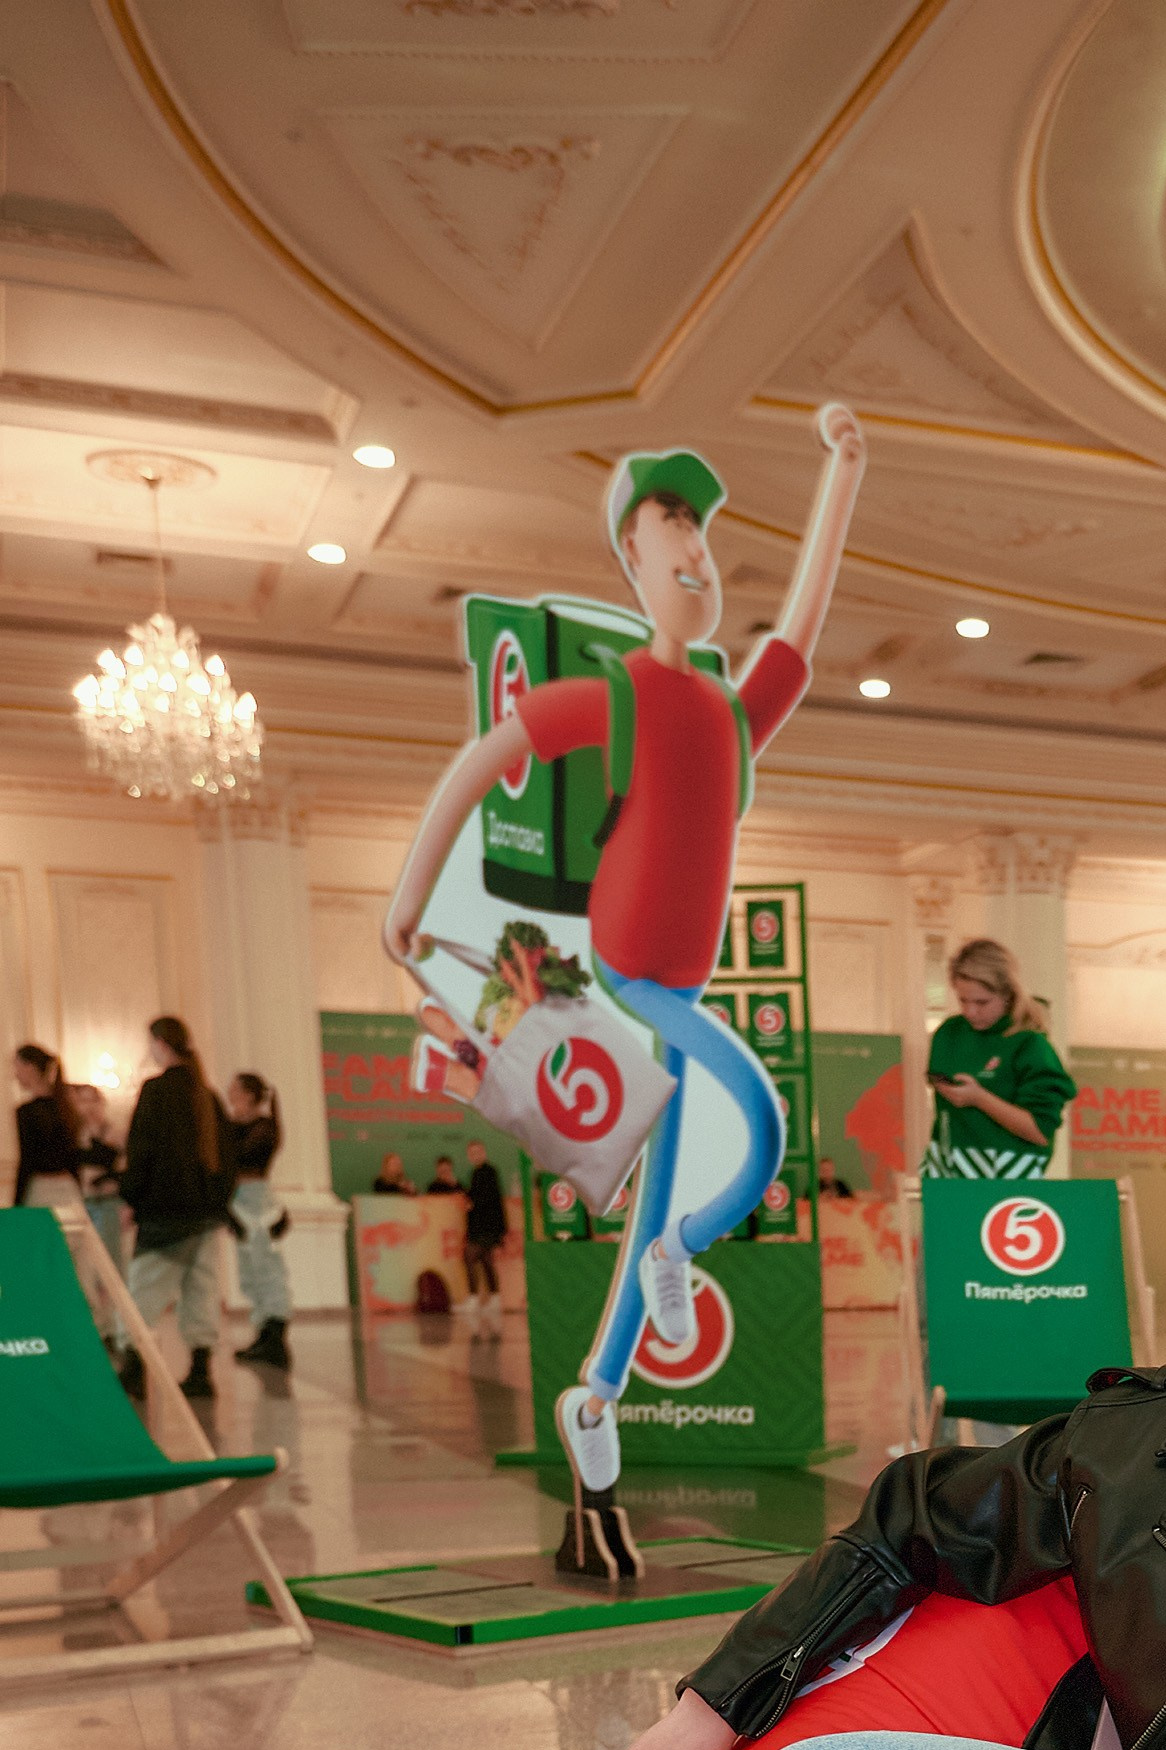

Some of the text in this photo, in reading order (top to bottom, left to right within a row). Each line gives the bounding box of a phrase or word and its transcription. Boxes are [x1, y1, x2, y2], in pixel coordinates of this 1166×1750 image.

[1074, 1086, 1161, 1113] AME
[1004, 1205, 1044, 1261] 5
[964, 1281, 1088, 1304] Пятёрочка
